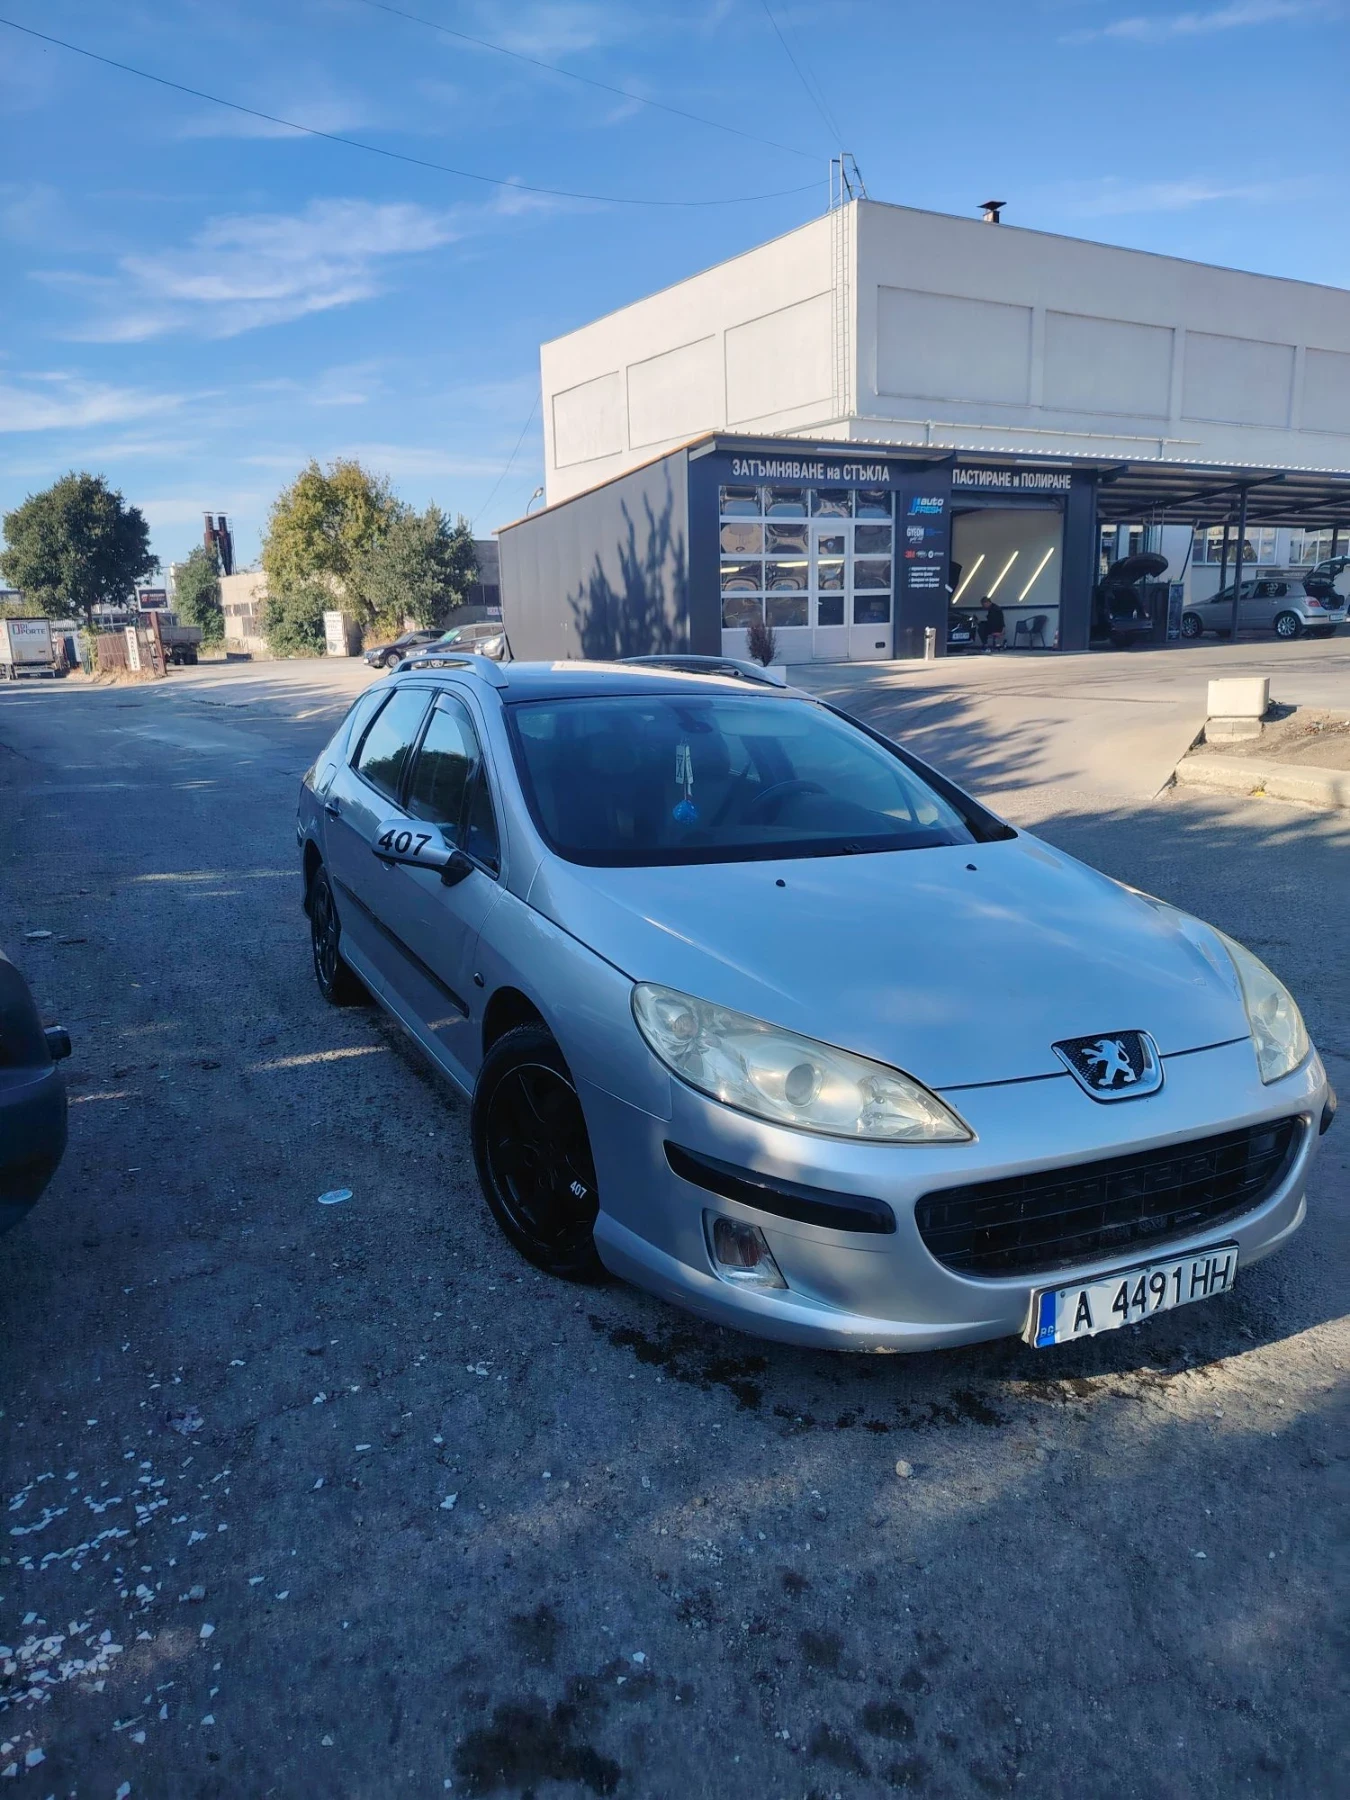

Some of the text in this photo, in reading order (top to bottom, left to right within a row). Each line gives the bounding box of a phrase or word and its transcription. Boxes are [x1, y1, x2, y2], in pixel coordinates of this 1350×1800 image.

[732, 459, 891, 482] ЗАТЪМНЯВАНЕ на СТЪКЛА
[952, 469, 1072, 489] ПАСТИРАНЕ и ПОЛИРАНЕ
[914, 506, 943, 514] FRESH
[920, 497, 944, 506] auto
[378, 829, 433, 856] 407
[570, 1180, 588, 1199] 407
[1074, 1291, 1092, 1332] A
